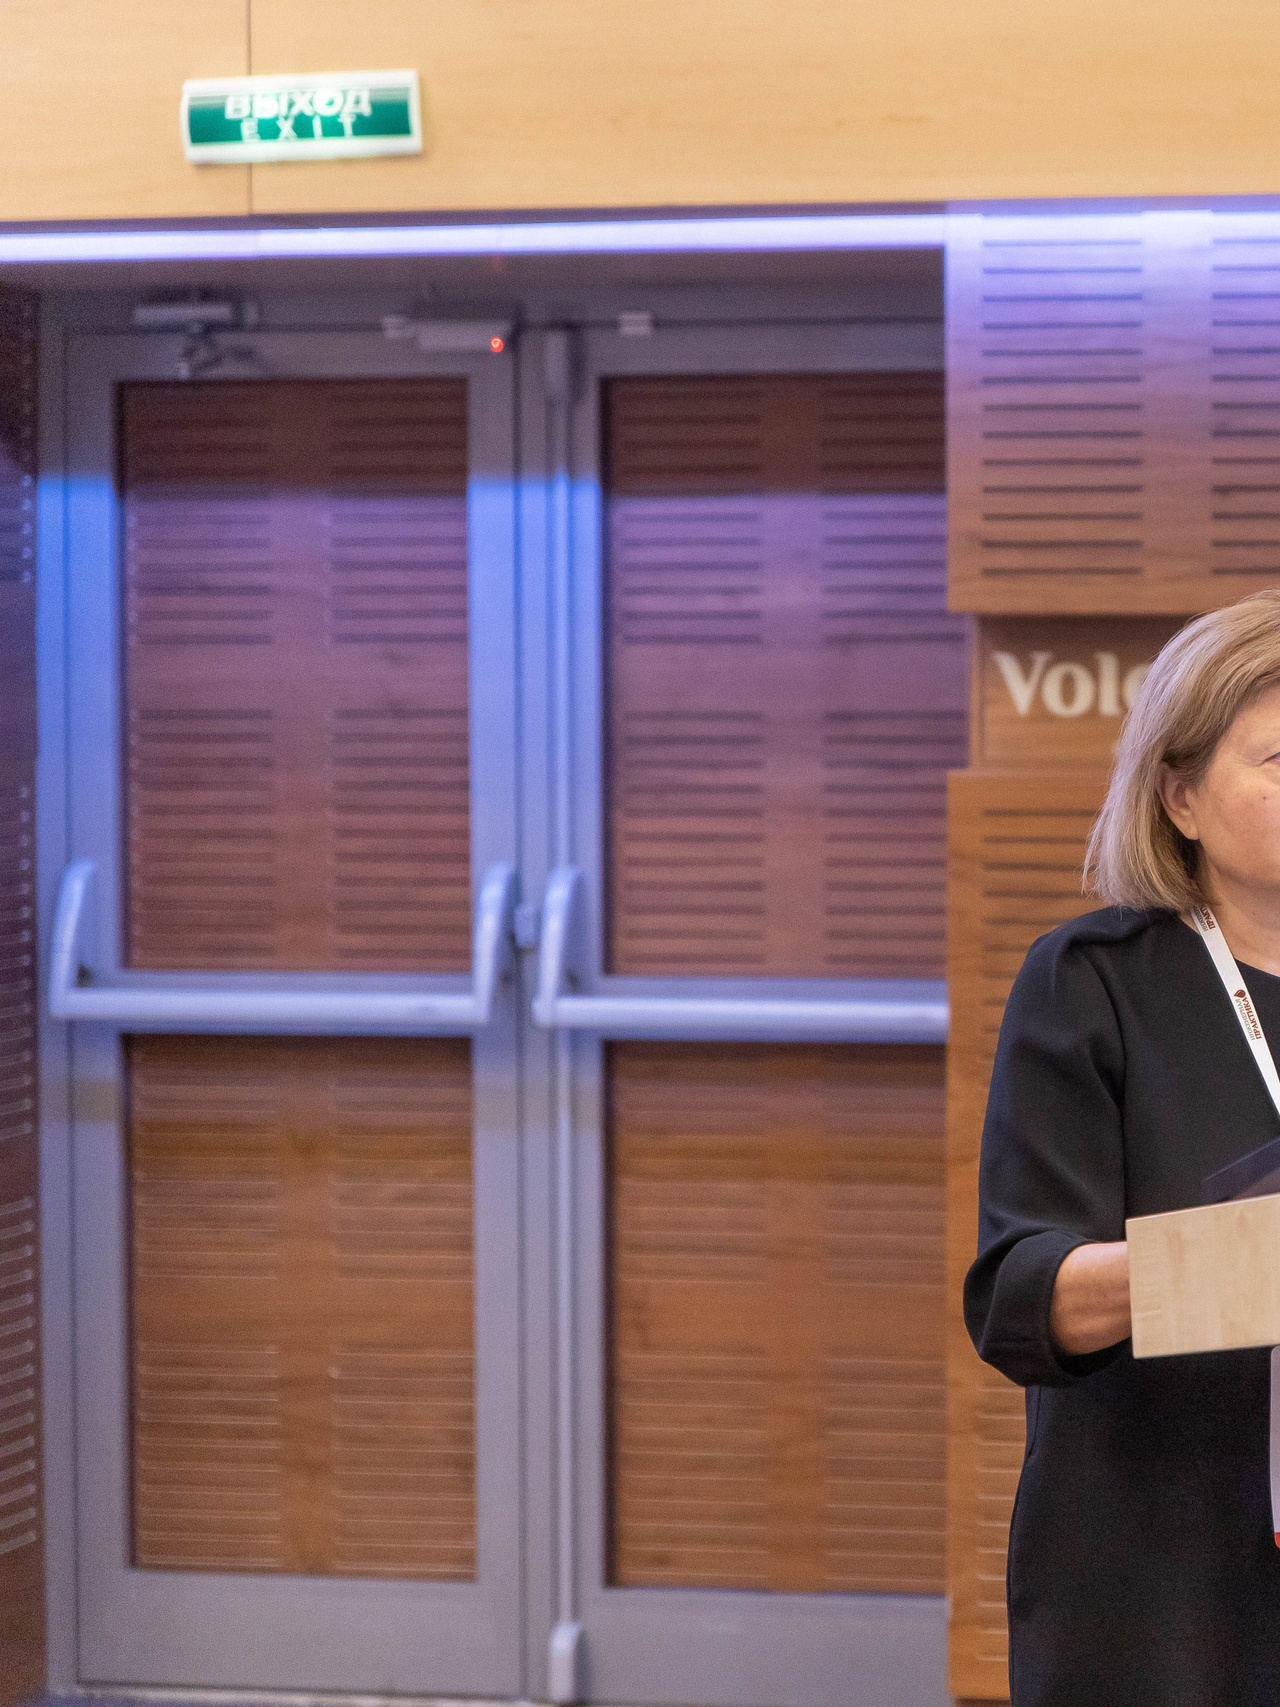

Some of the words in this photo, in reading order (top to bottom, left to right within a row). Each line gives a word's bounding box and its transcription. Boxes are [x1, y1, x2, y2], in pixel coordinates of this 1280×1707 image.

[224, 87, 372, 119] ВЫХОД
[240, 114, 356, 143] EXIT
[1201, 906, 1216, 930] ПРАКТ
[1241, 996, 1262, 1039] ПРАКТИКА
